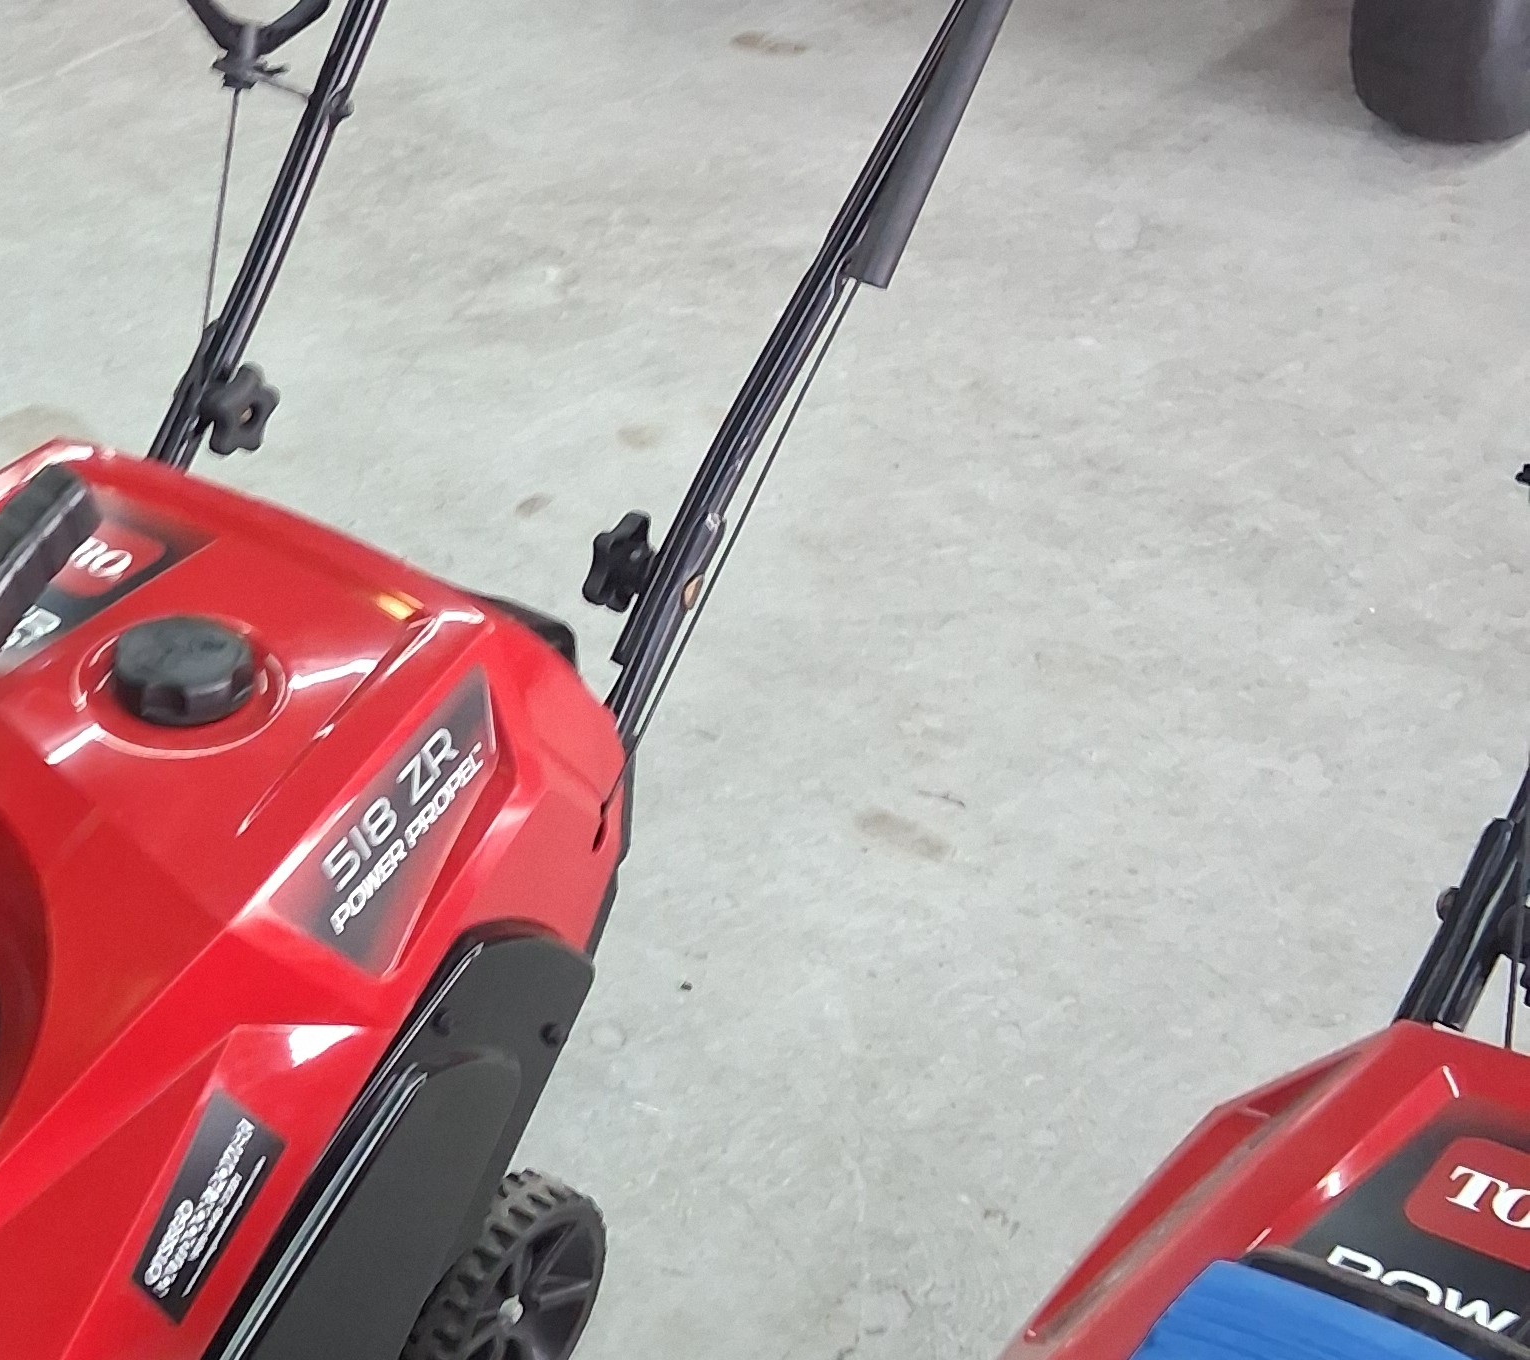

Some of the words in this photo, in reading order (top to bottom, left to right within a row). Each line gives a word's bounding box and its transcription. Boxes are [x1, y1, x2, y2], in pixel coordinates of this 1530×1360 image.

[321, 796, 398, 893] 518
[396, 727, 460, 807] ZR
[329, 838, 408, 936] POWER
